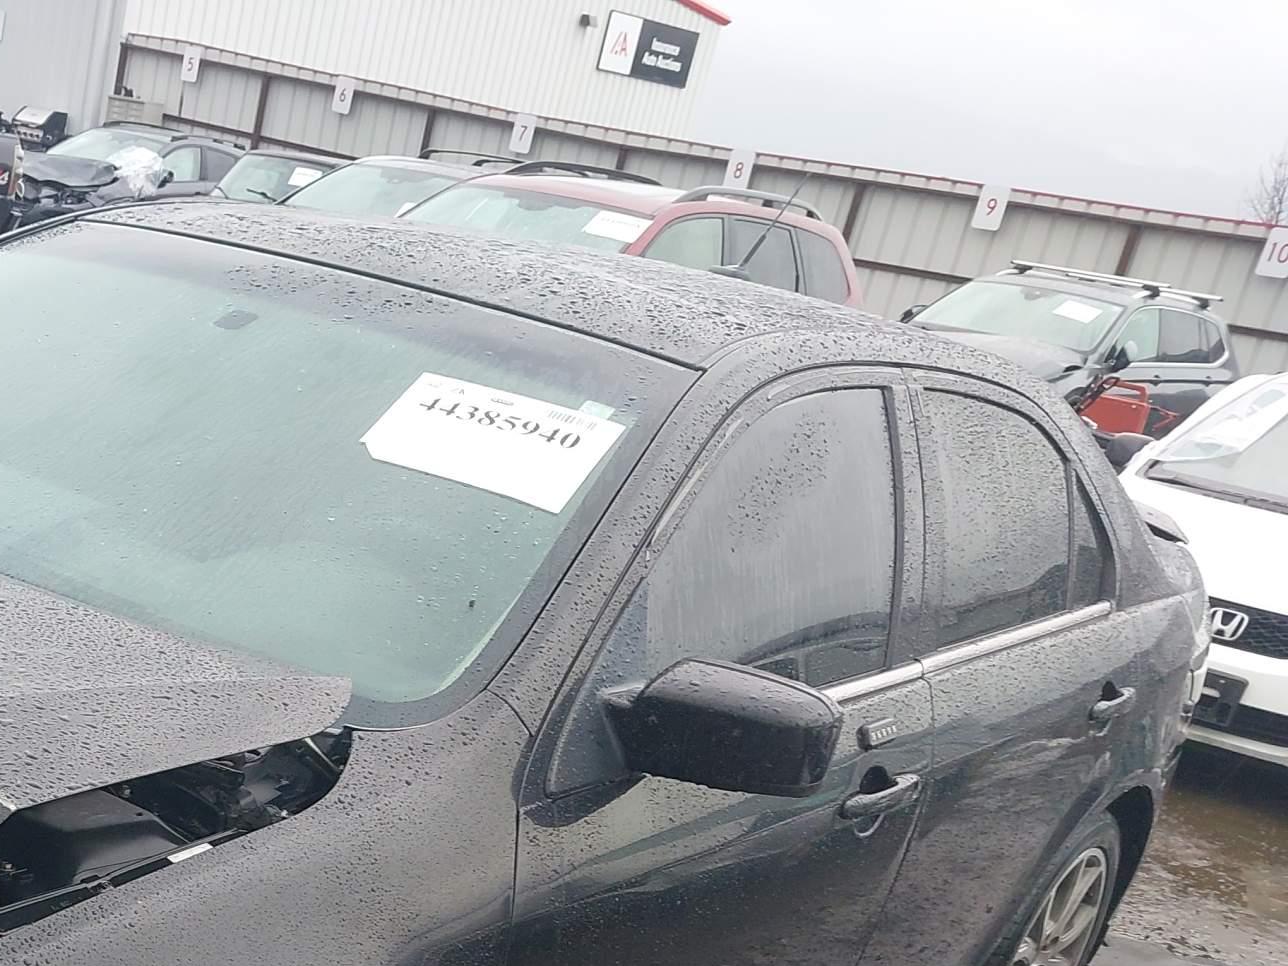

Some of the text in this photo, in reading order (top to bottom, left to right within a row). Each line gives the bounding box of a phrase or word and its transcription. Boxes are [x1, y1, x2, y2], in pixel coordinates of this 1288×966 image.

[186, 57, 194, 72] 5
[338, 88, 347, 103] 6
[518, 124, 529, 143] 7
[732, 162, 745, 180] 8
[985, 197, 999, 217] 9
[418, 397, 582, 449] 44385940
